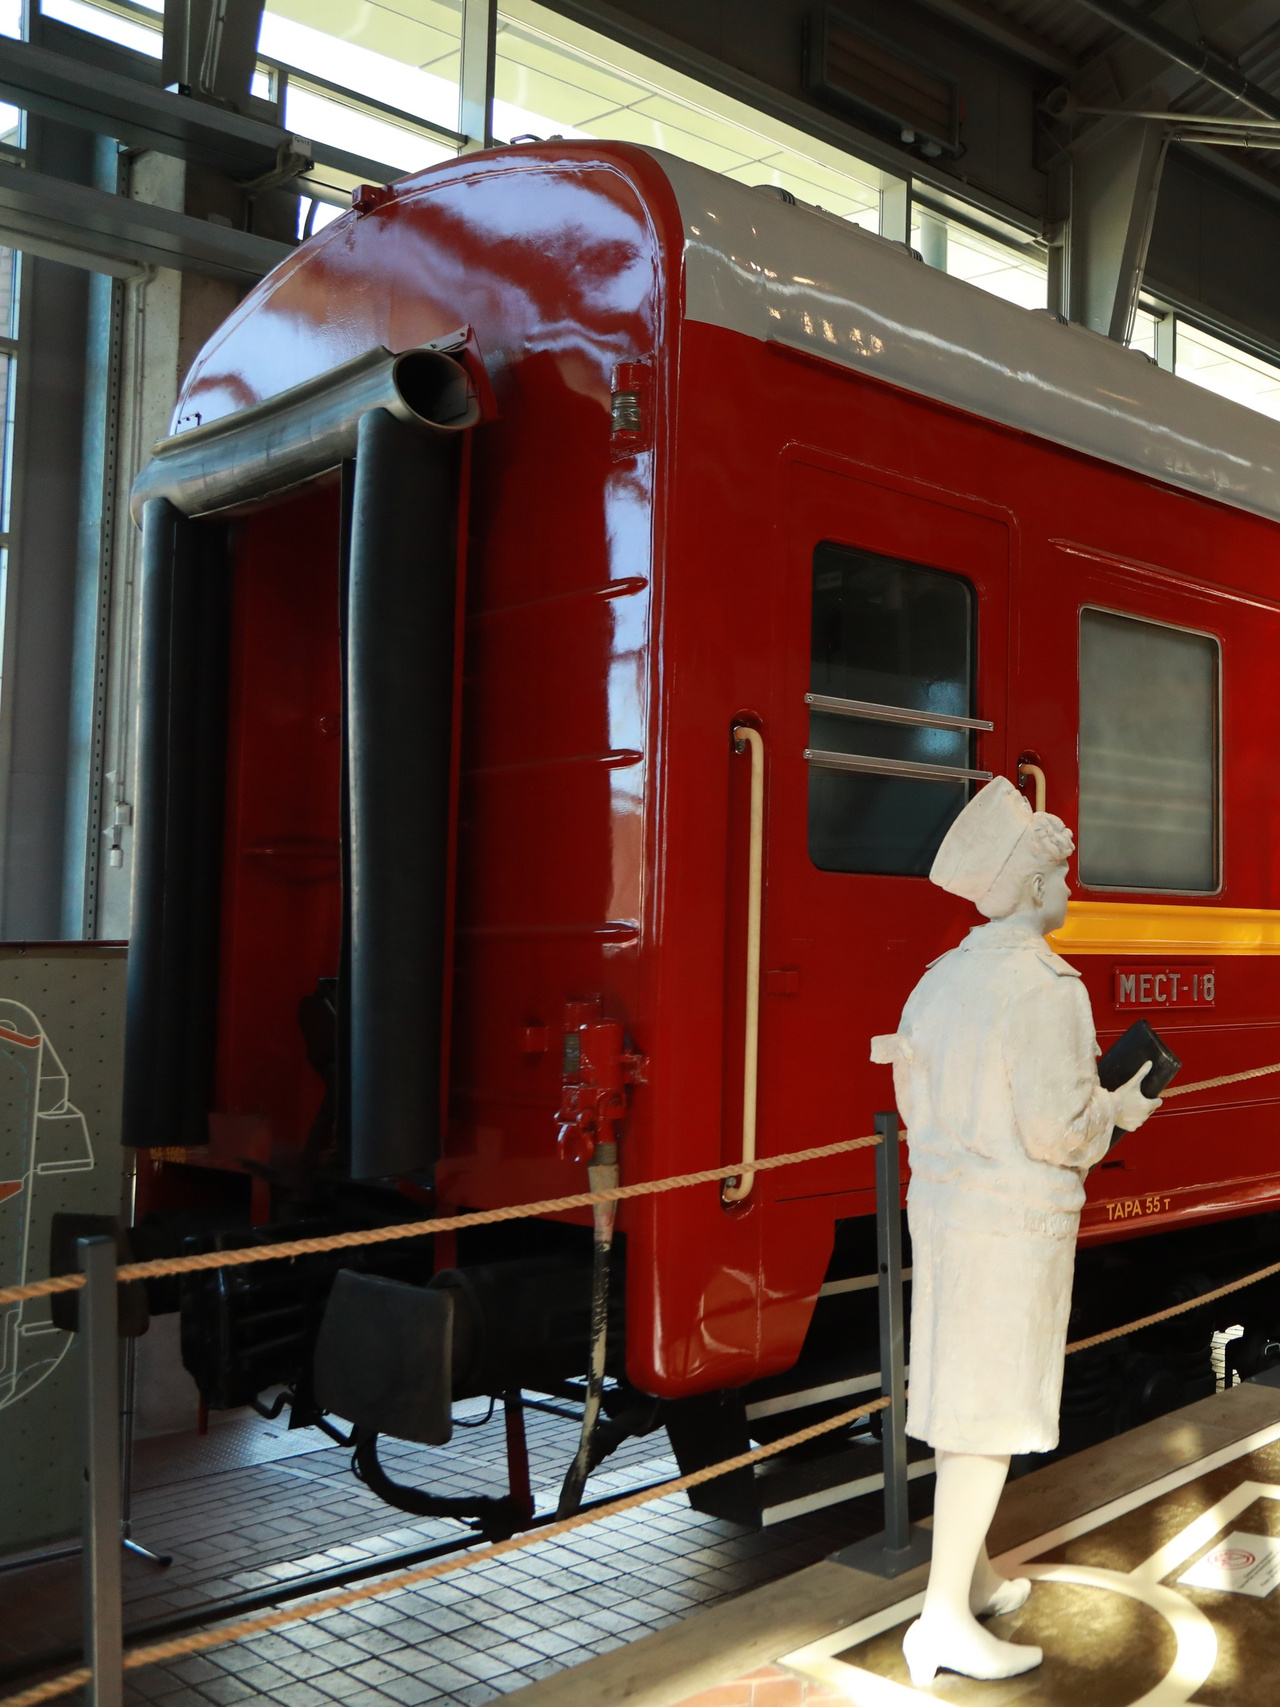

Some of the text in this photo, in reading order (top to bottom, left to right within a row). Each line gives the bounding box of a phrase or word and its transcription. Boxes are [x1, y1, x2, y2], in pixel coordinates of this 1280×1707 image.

[1119, 973, 1216, 1003] МЕСТ-18
[1106, 1199, 1143, 1221] ТАРА
[1146, 1197, 1161, 1215] 55
